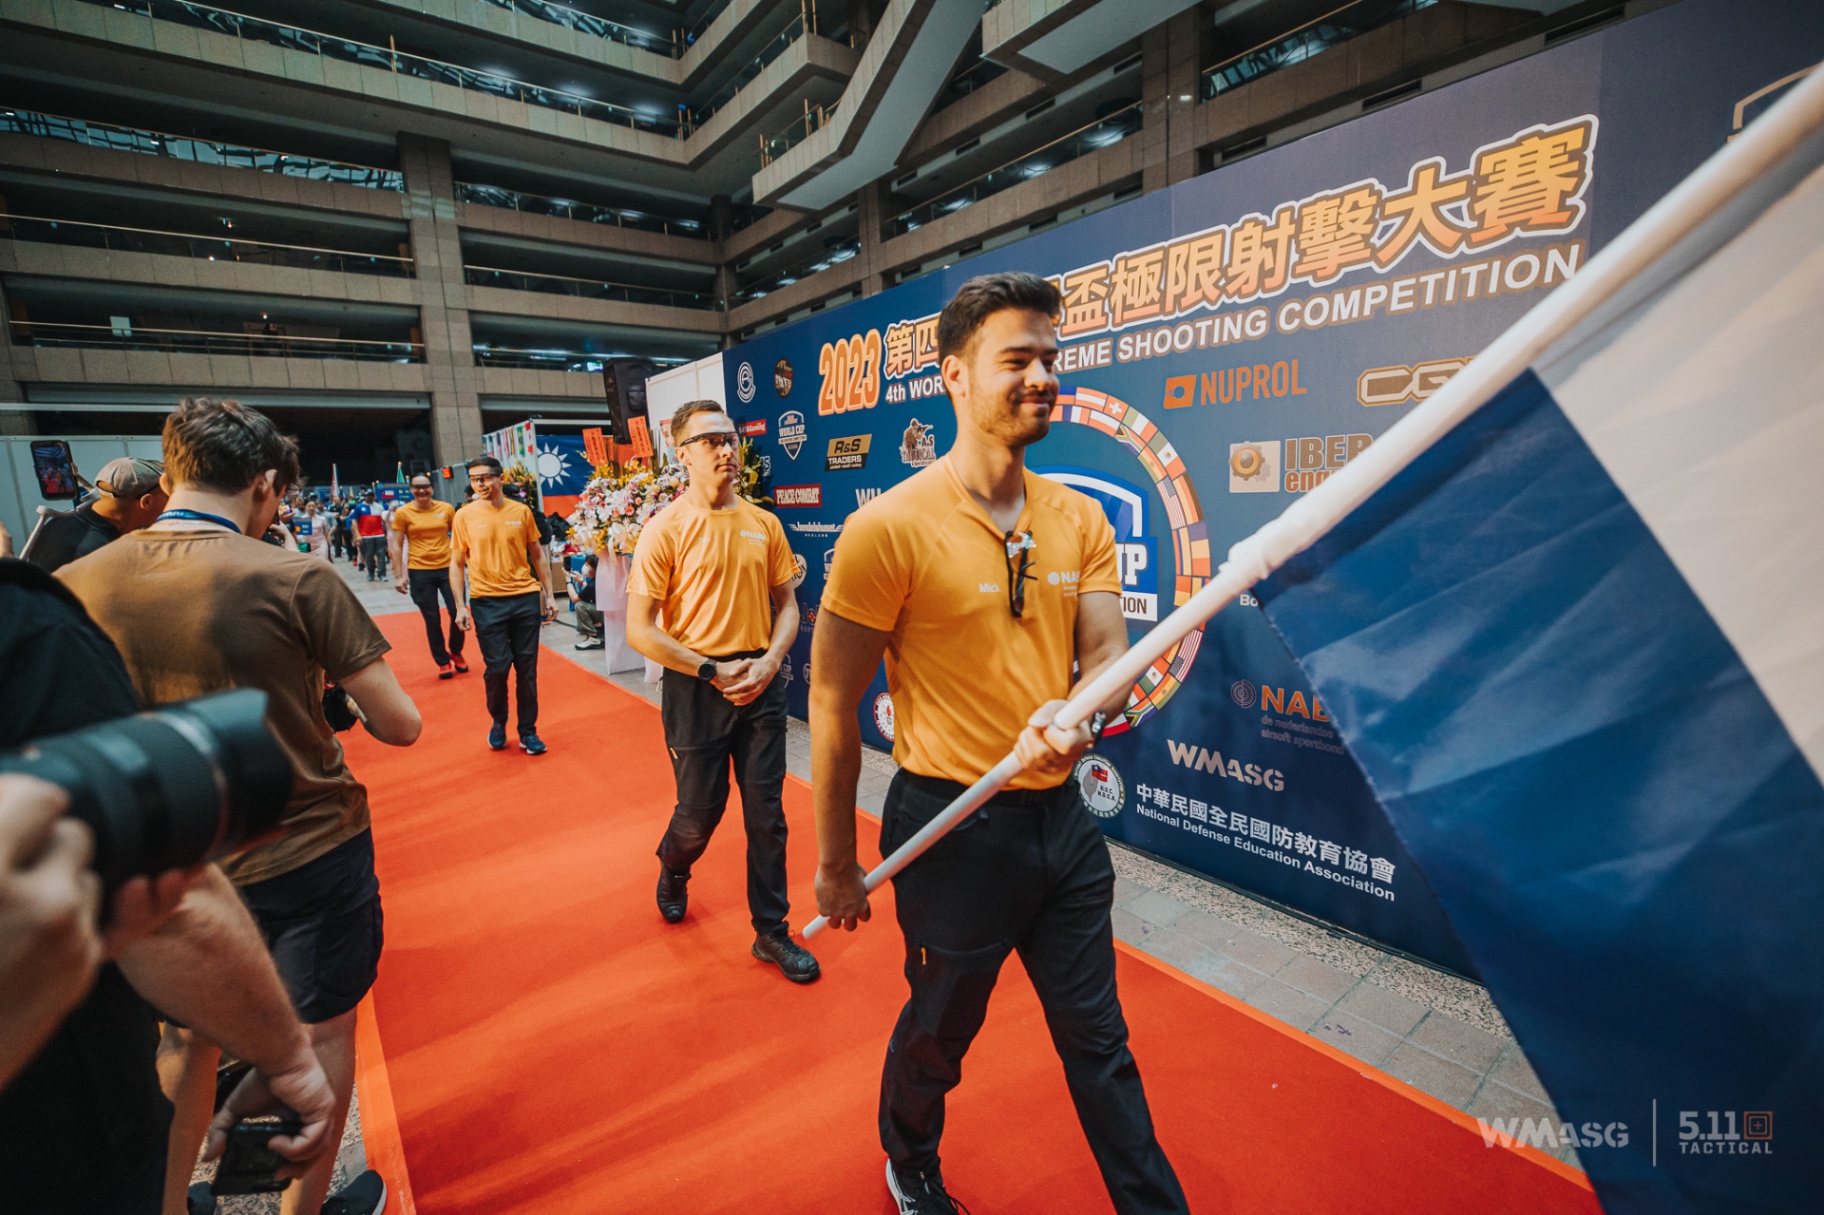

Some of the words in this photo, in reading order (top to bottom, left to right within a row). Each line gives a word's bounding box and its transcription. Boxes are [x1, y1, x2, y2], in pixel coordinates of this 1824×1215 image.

[886, 384, 906, 402] 4th
[909, 375, 945, 399] WOR
[1054, 340, 1112, 372] REME
[1118, 309, 1267, 360] SHOOTING
[1279, 243, 1580, 331] COMPETITION
[818, 330, 882, 416] 2023
[1200, 359, 1307, 406] NUPROL
[828, 455, 862, 465] TRADERS
[1240, 594, 1259, 607] Bo
[1167, 739, 1284, 791] WMASG
[1136, 783, 1396, 885] 中華民國全民國防教育協會
[1136, 803, 1180, 828] National
[1183, 819, 1231, 845] Defense
[1234, 836, 1301, 869] Education
[1304, 860, 1395, 902] Association
